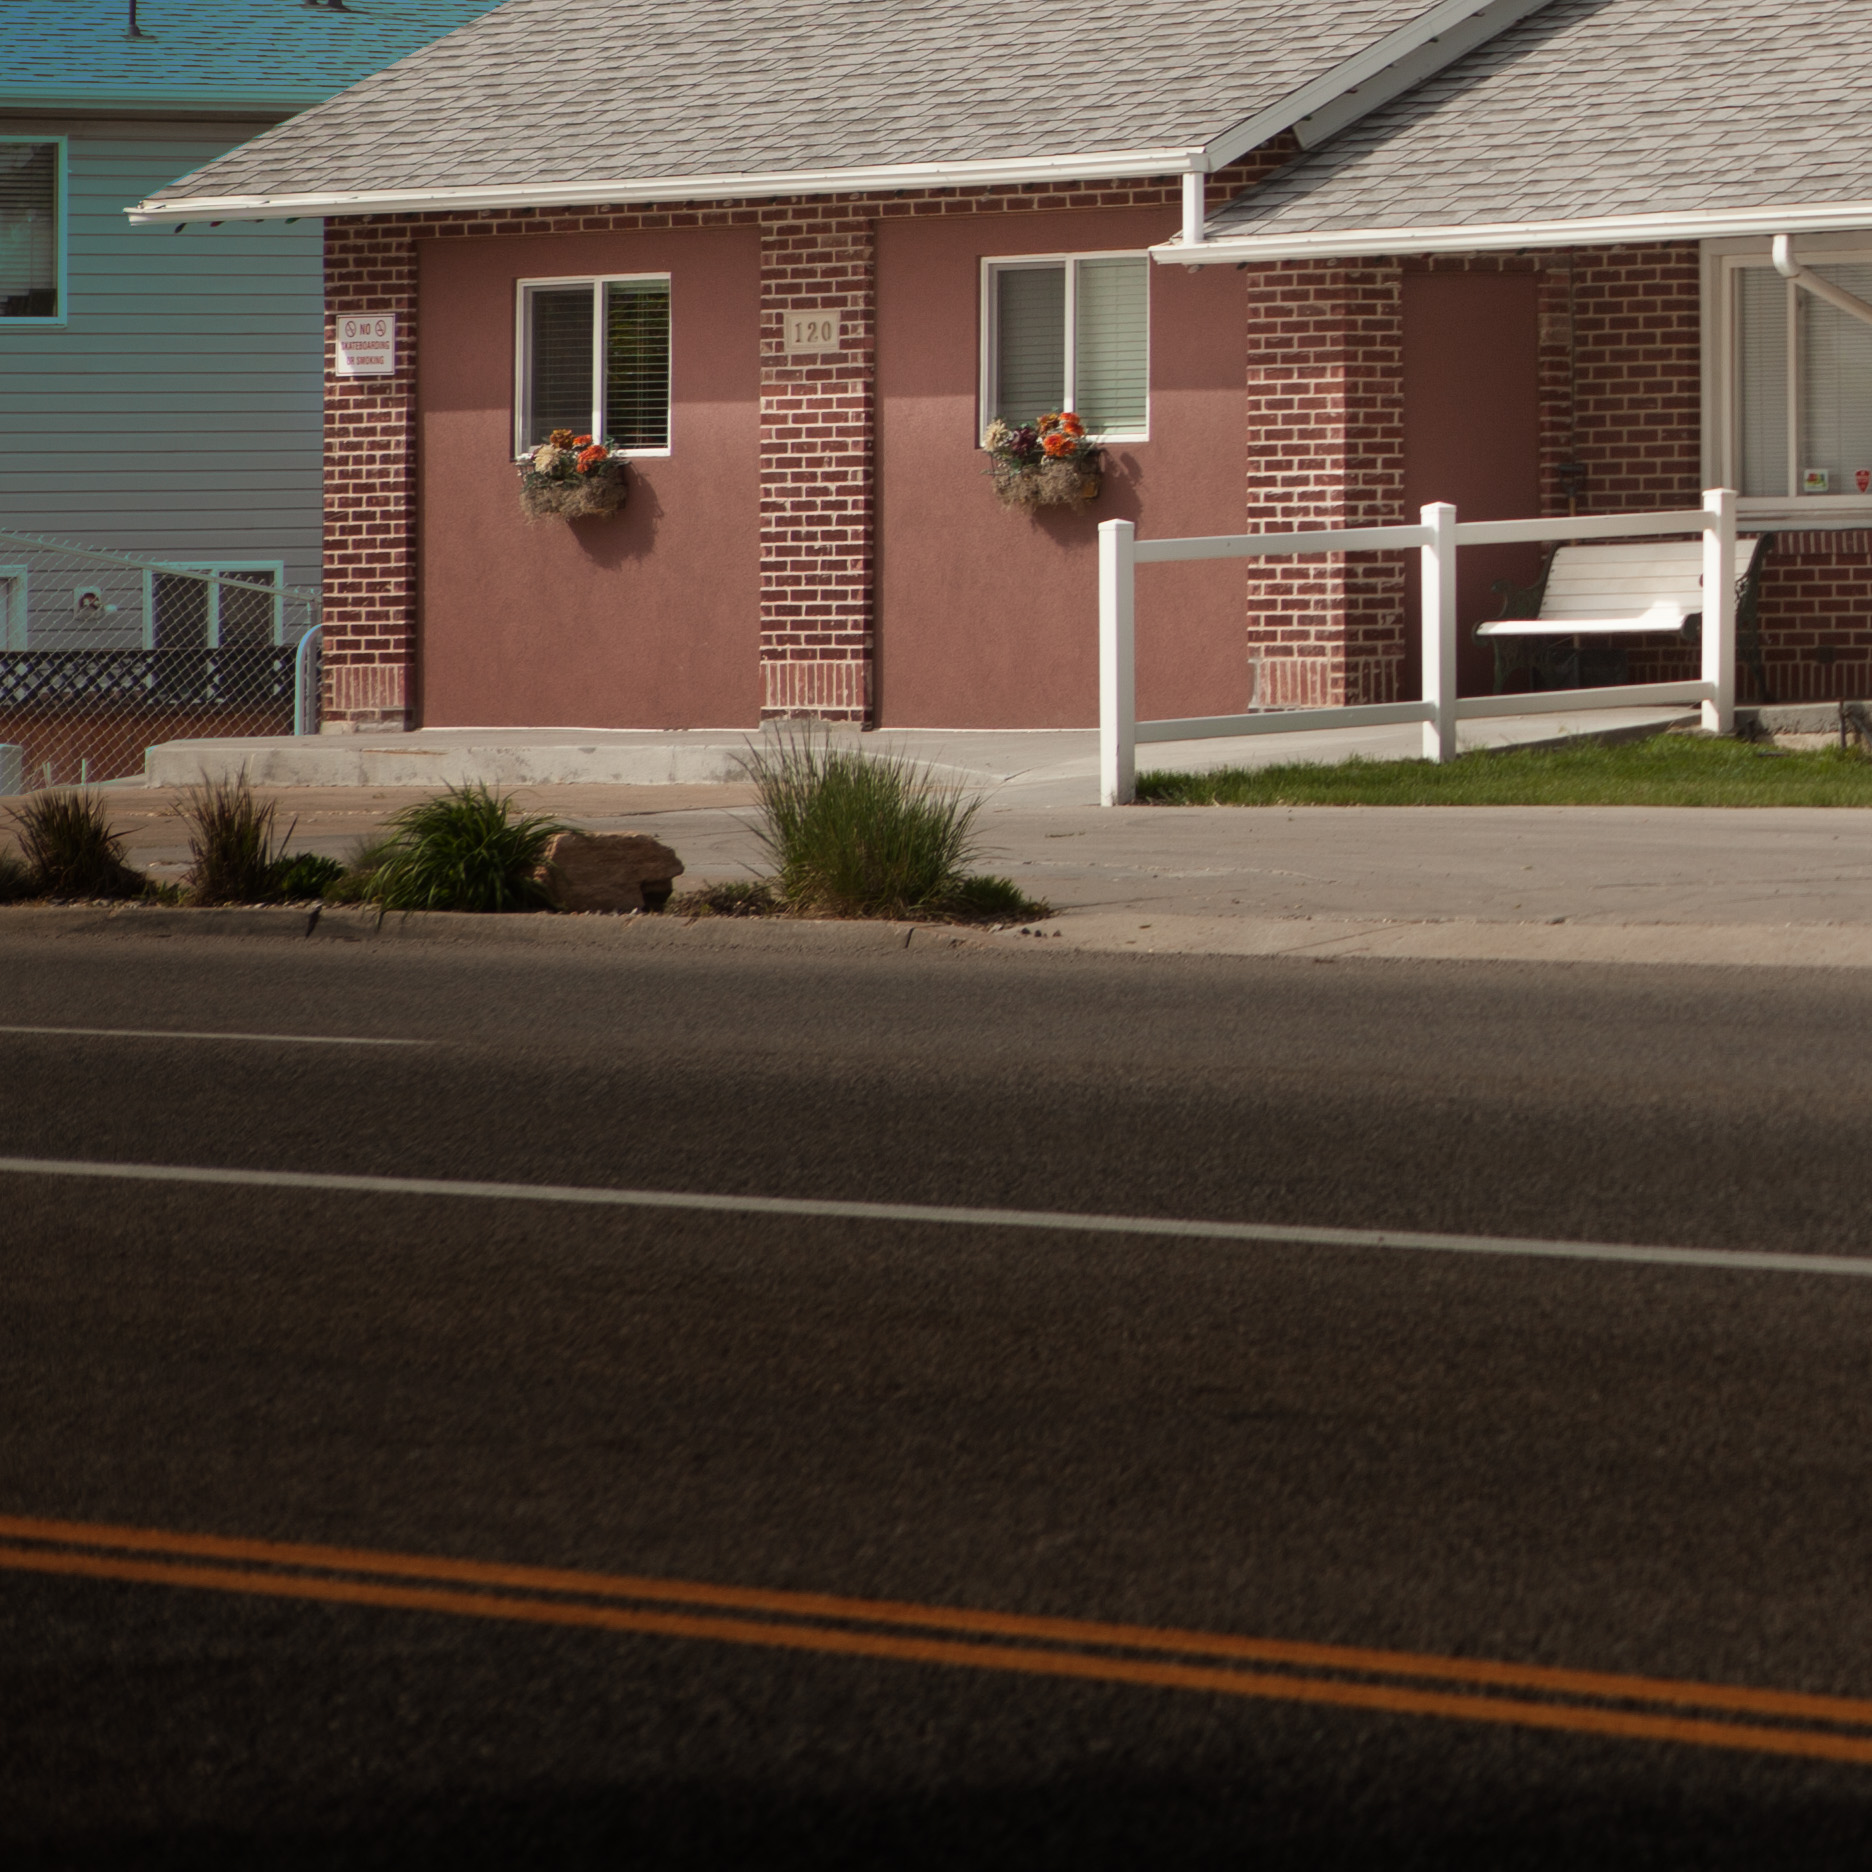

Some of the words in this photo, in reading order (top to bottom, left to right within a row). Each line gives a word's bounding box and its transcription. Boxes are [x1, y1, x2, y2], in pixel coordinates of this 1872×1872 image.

[360, 323, 371, 335] NO
[795, 321, 832, 343] 120
[341, 341, 390, 350] SKATEBOARDING
[347, 356, 355, 365] OR
[356, 356, 384, 365] SMOKING
